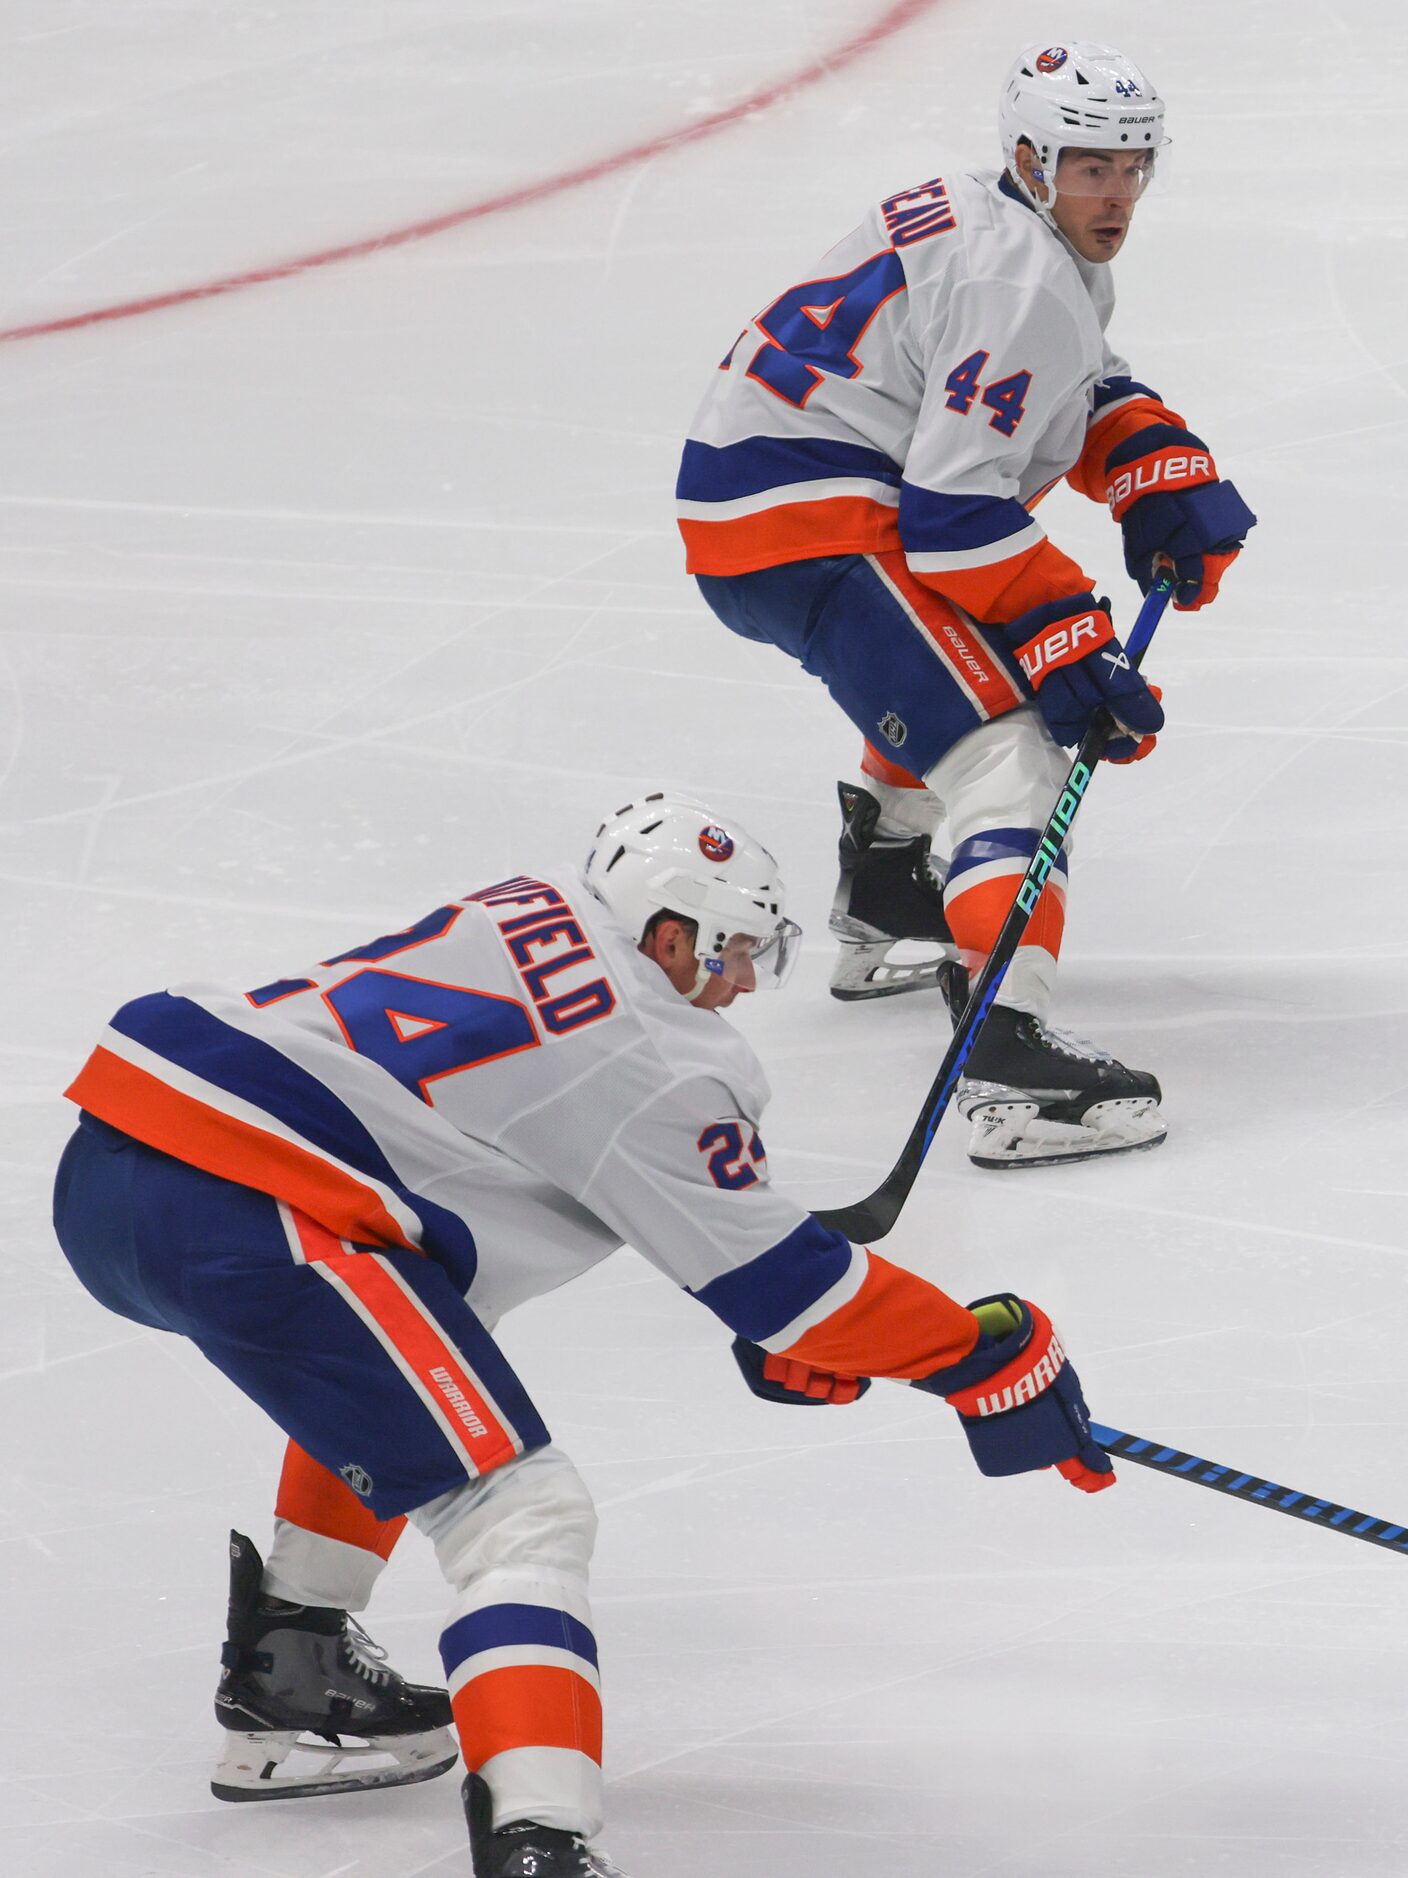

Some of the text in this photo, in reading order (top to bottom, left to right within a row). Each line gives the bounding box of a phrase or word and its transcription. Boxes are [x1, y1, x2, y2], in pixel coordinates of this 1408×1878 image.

[1115, 79, 1143, 98] 44
[1118, 116, 1156, 125] BAUER
[943, 349, 1034, 438] 44
[941, 625, 989, 684] BAUER
[429, 1366, 489, 1439] WARRIOR
